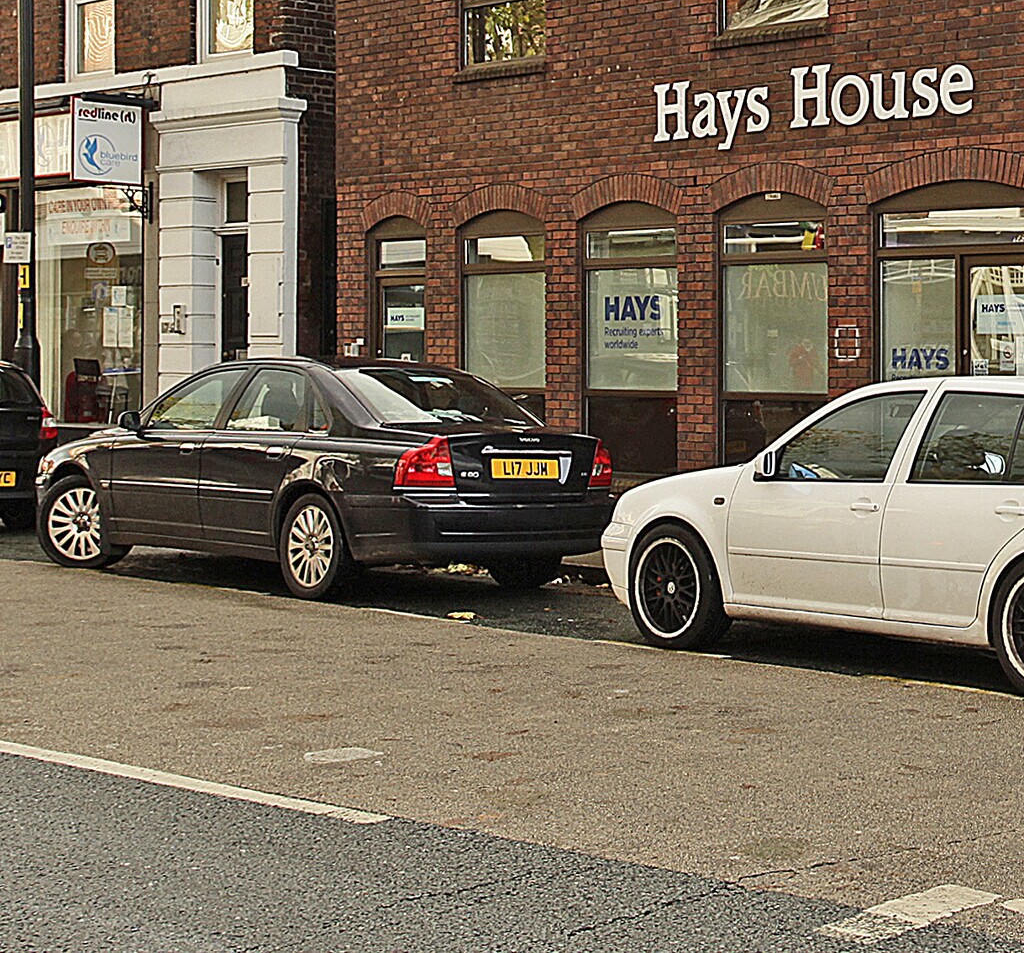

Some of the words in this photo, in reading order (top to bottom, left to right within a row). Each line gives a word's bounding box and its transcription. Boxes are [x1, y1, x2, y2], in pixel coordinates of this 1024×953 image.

[653, 80, 770, 150] Hays
[790, 63, 974, 128] House
[100, 151, 138, 162] bluebird
[604, 295, 663, 321] HAYS
[981, 304, 1006, 313] HAYS
[604, 327, 637, 338] Recruiting
[604, 339, 638, 349] worldwide
[892, 348, 949, 370] HAYS
[503, 461, 522, 476] L17
[526, 462, 548, 476] JJM
